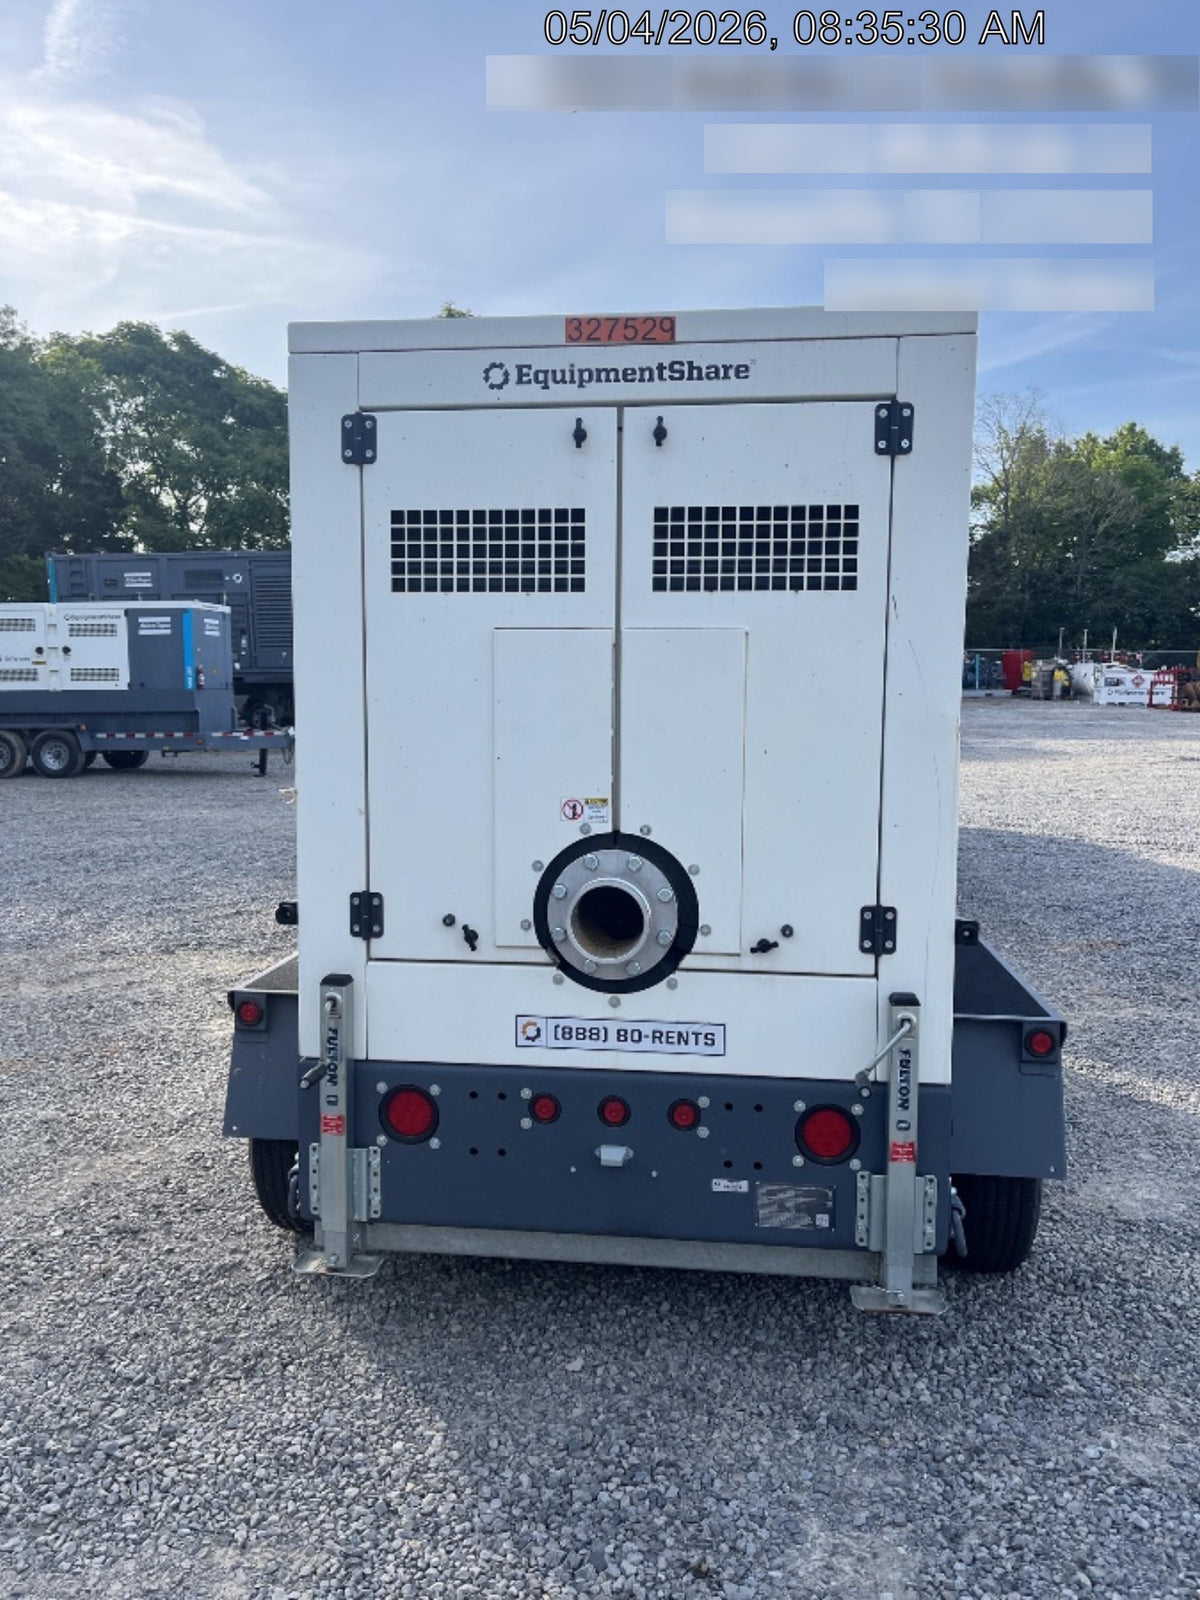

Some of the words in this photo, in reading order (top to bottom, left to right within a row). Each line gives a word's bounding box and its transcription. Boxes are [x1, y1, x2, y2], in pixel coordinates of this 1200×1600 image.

[567, 316, 675, 343] 327529
[514, 359, 751, 390] EquipmentShare
[553, 1023, 609, 1044] (888)
[616, 1027, 717, 1047] 80-RENTS
[897, 1048, 912, 1111] FULTON
